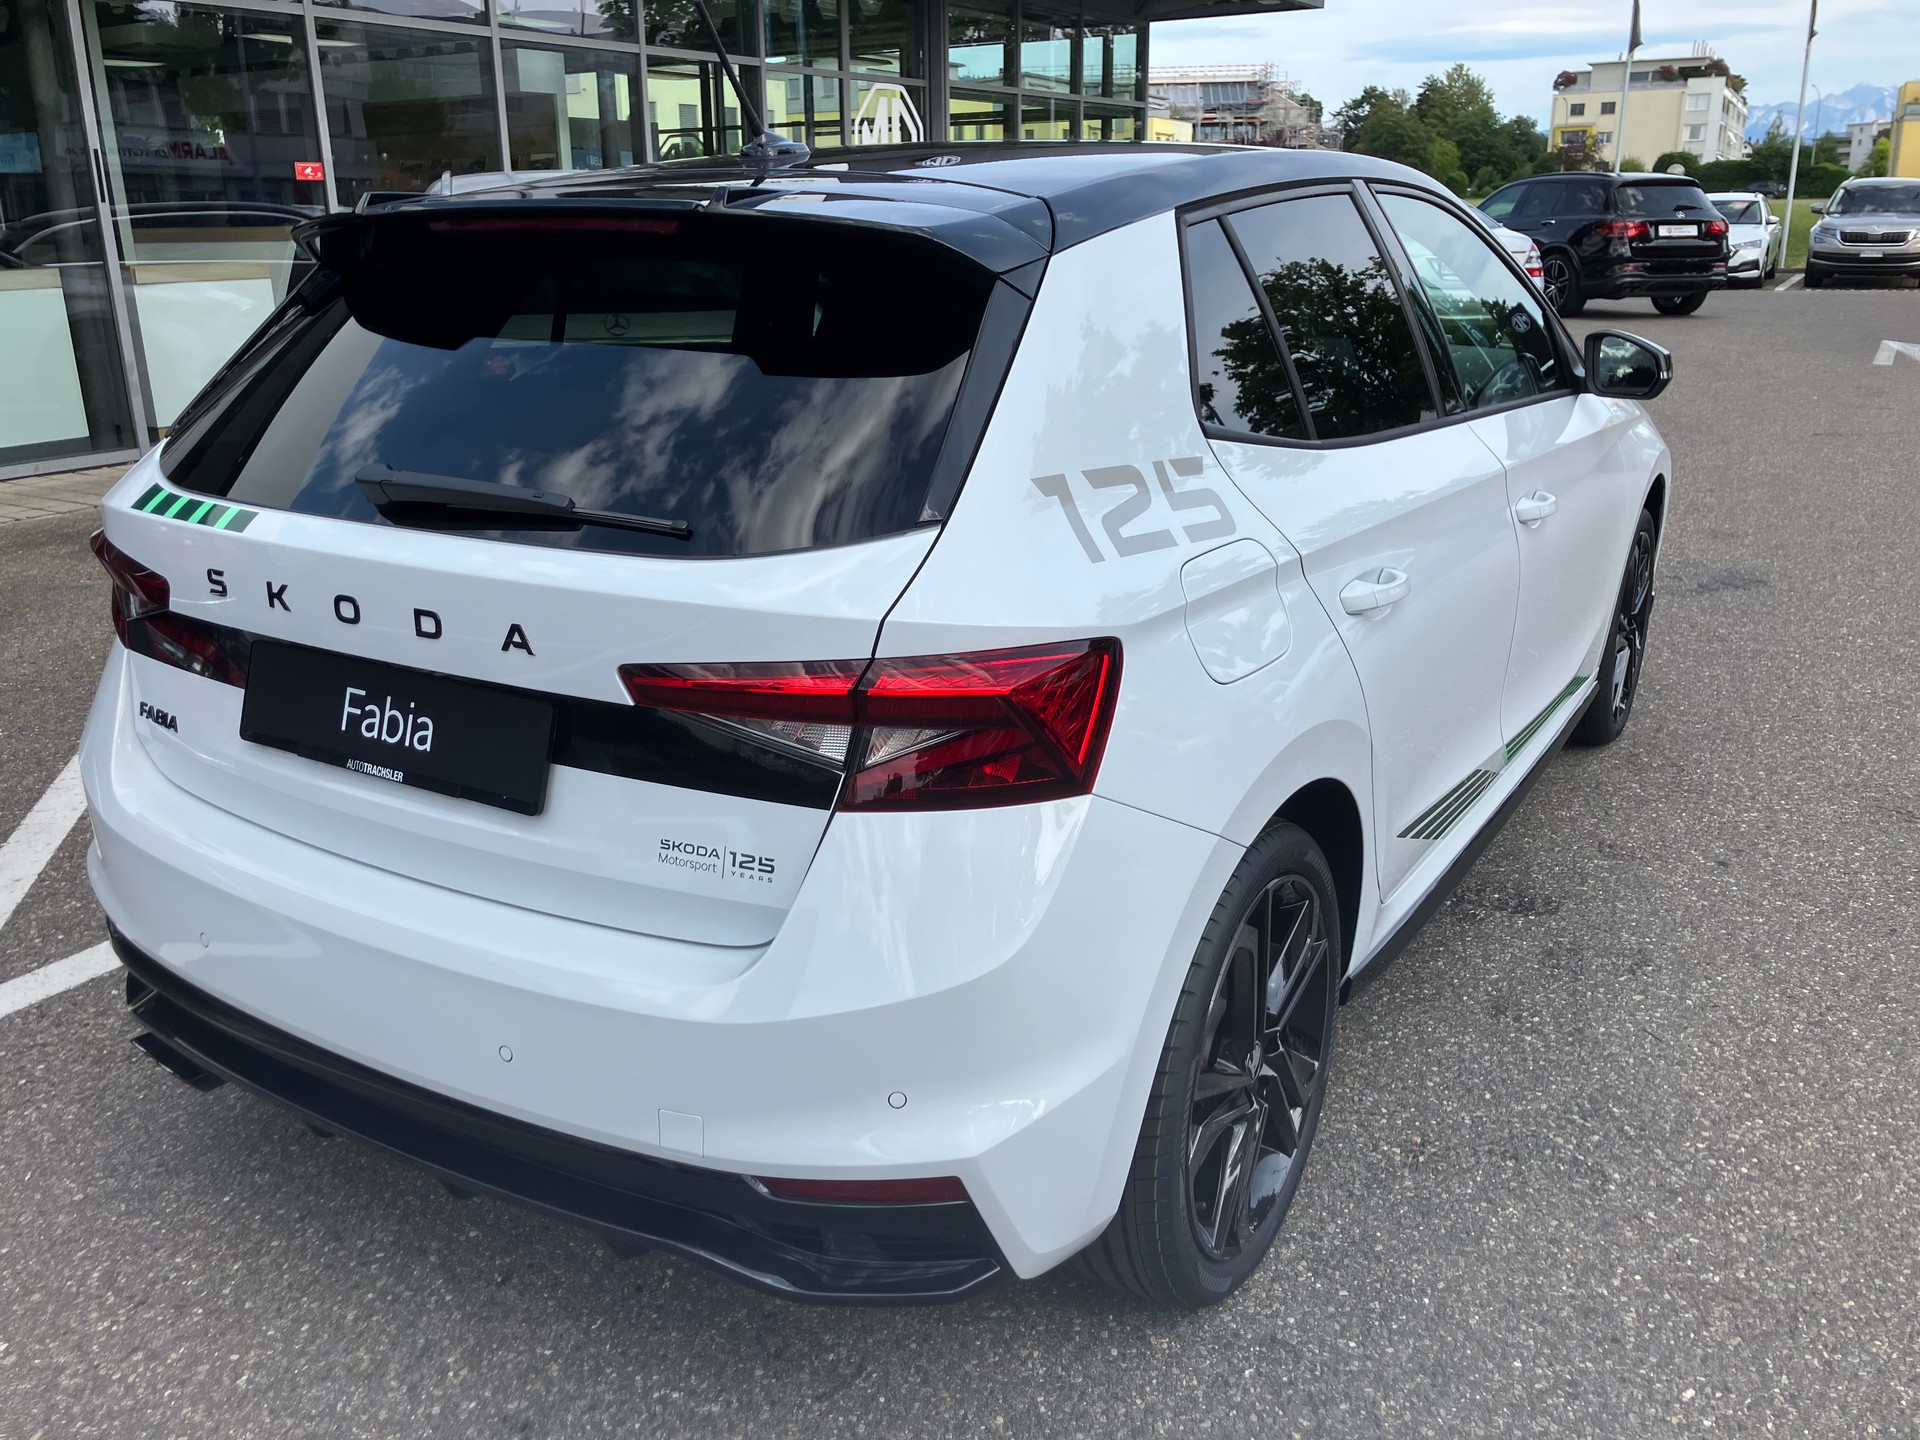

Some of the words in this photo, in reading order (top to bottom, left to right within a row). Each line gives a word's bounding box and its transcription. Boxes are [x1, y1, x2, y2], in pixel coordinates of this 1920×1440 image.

[1031, 456, 1236, 563] 125
[139, 701, 178, 733] FABIA
[341, 687, 434, 752] Fabia
[346, 758, 404, 782] AUTOTRACHSLER
[657, 852, 718, 873] Motorsport
[729, 851, 776, 874] 125
[731, 870, 773, 884] YEARS
